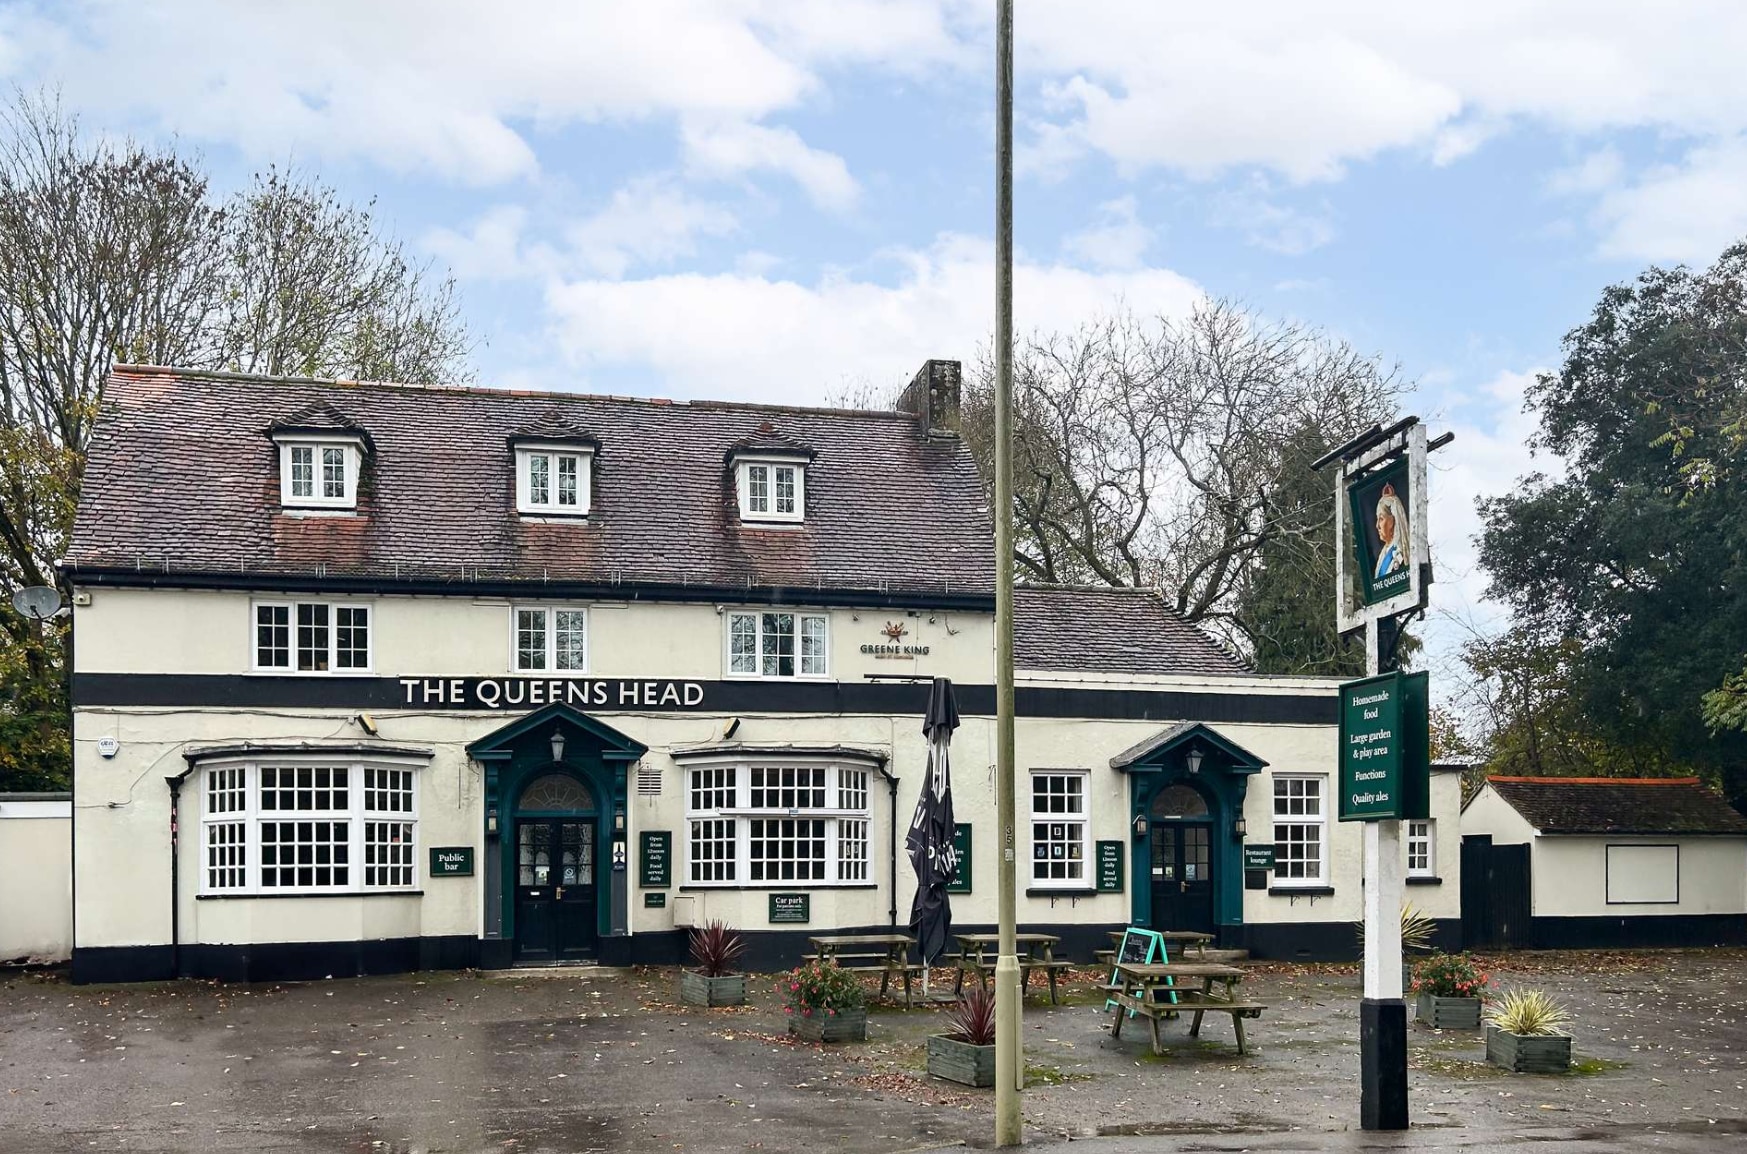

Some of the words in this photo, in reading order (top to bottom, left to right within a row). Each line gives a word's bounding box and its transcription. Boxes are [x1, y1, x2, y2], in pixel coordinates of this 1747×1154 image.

[1372, 580, 1383, 591] THE
[1383, 572, 1406, 588] QUEENS
[860, 644, 900, 654] GREENE
[903, 645, 930, 655] KING
[400, 679, 464, 703] THE
[476, 680, 608, 708] QUEENS
[619, 682, 705, 706] HEAD
[1352, 690, 1390, 706] Homemade
[1363, 707, 1379, 720] food
[1350, 733, 1368, 744] Large
[1368, 728, 1391, 743] garden
[1353, 749, 1359, 758] &
[1359, 746, 1374, 760] play
[1373, 746, 1388, 756] area
[1355, 769, 1386, 781] Functions
[1352, 792, 1375, 806] Quality
[1375, 790, 1389, 802] ales
[438, 853, 465, 862] Public
[1250, 856, 1267, 865] lounge
[444, 862, 459, 870] bar
[775, 896, 787, 904] Car
[788, 896, 803, 905] park
